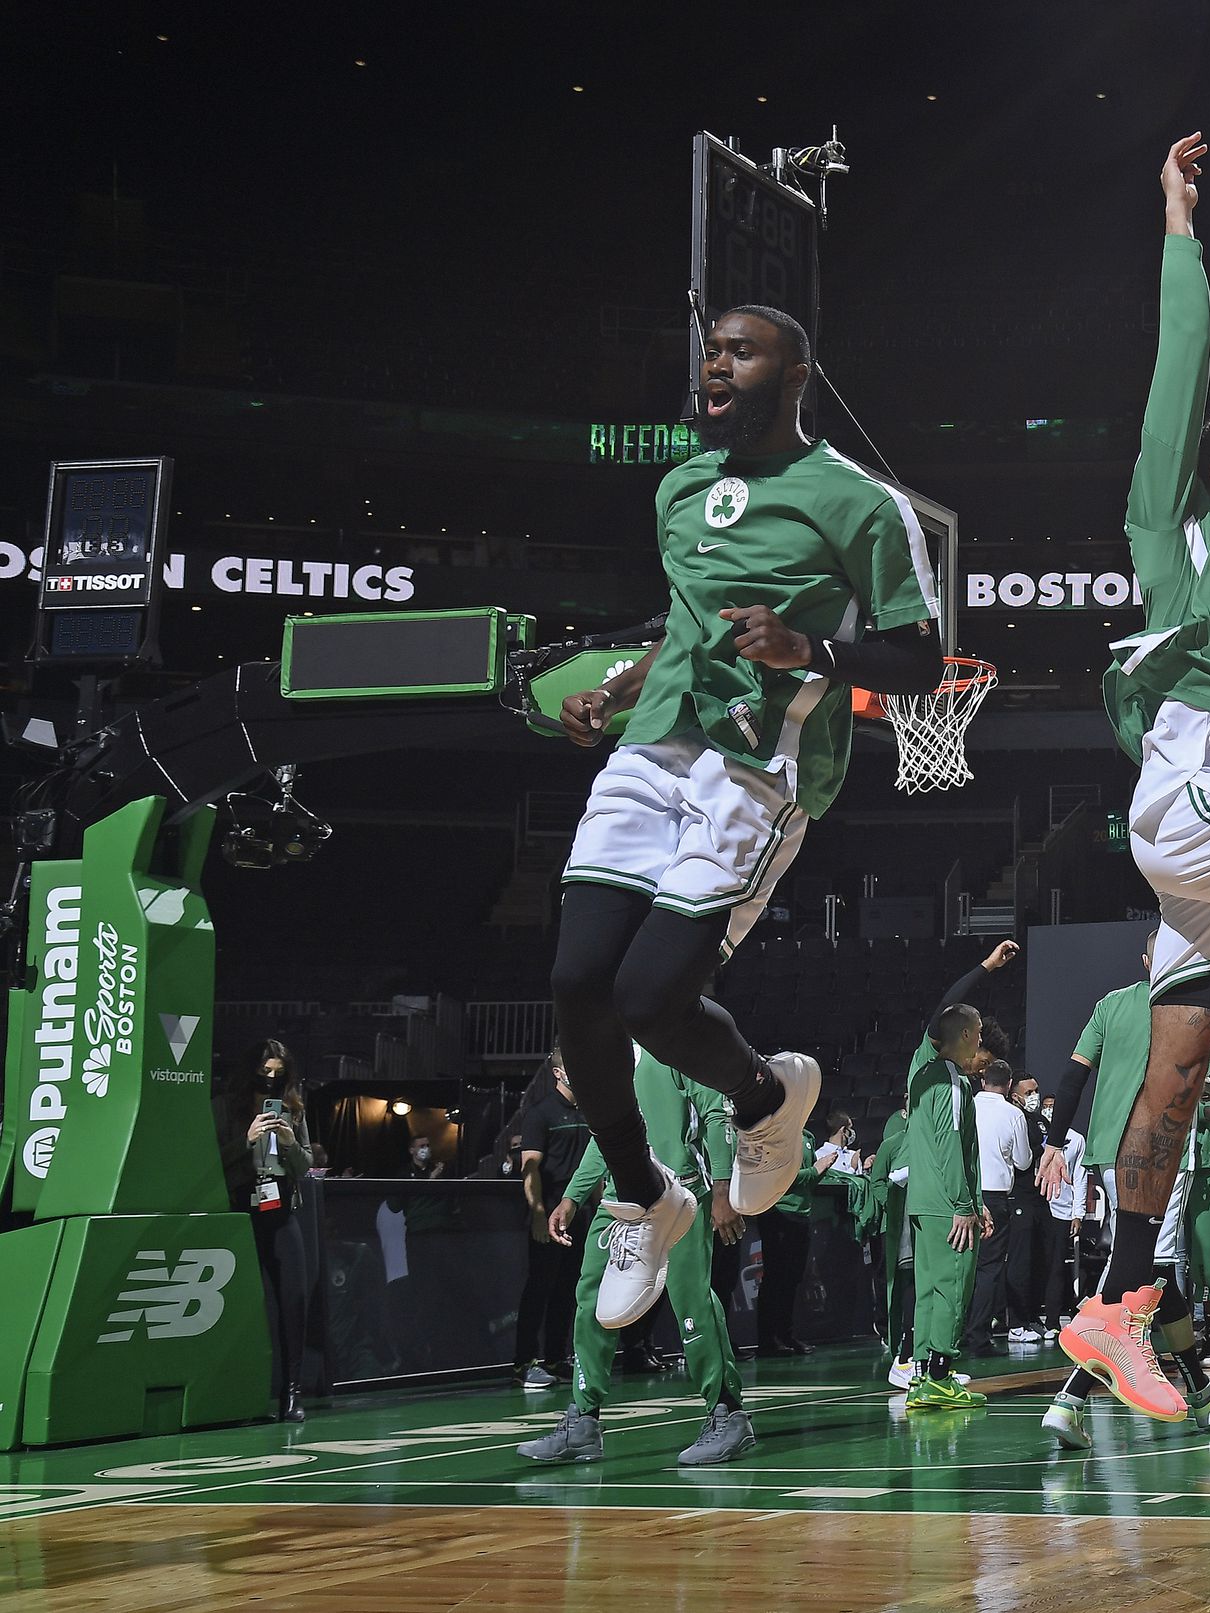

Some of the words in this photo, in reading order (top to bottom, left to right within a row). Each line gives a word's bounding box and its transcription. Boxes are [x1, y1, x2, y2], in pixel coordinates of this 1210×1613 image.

[711, 481, 746, 502] CELTICS
[73, 573, 145, 591] TISSOT
[211, 556, 415, 602] CELTICS
[29, 885, 82, 1121] Putnam
[84, 922, 119, 1046] Sports
[116, 945, 138, 1055] BOSTON
[150, 1068, 204, 1084] vistaprint
